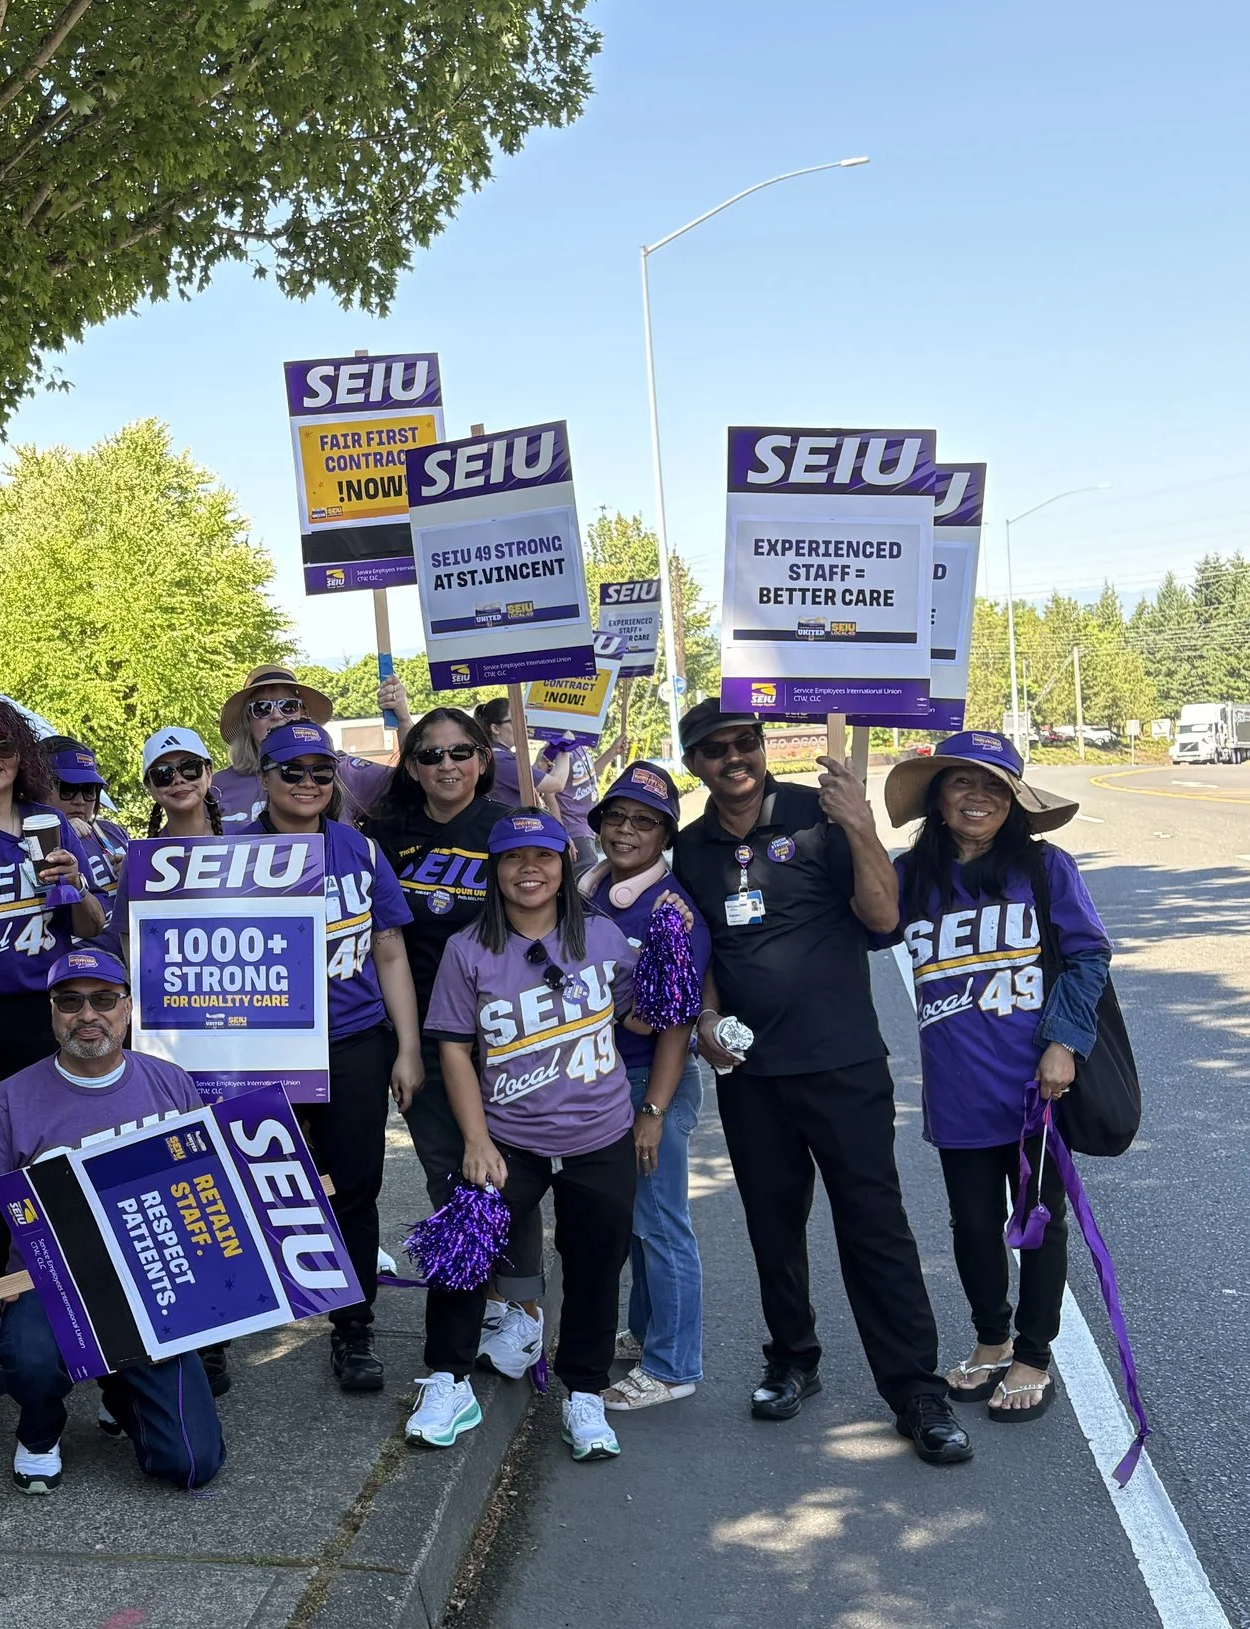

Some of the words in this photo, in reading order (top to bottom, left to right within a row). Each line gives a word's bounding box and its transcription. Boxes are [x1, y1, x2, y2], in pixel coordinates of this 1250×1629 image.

[303, 360, 428, 408] SEIU
[320, 431, 362, 451] FAIR
[366, 427, 418, 447] FIRST
[325, 451, 407, 472] CONTRAC
[421, 431, 555, 497] SEIU
[747, 434, 922, 486] SEIU
[431, 550, 472, 568] SEIU
[475, 545, 492, 560] 49
[494, 535, 563, 558] STRONG
[753, 538, 902, 559] EXPERIENCED
[434, 572, 456, 590] AT
[788, 564, 850, 581] STAFF
[605, 582, 658, 603] SEIU
[759, 587, 836, 605] BETTER
[841, 588, 894, 607] CARE
[508, 603, 533, 612] SEIU
[608, 618, 652, 626] EXPERIENCED
[832, 623, 855, 632] SEIU
[500, 662, 525, 670] Employees
[452, 674, 470, 682] SEIU
[543, 680, 595, 691] CONTRACT
[544, 691, 586, 706] !NOW!
[751, 695, 776, 703] SEIU
[145, 843, 308, 892] SEIU
[400, 853, 487, 889] EIU
[456, 887, 473, 895] OUR
[164, 927, 287, 963] 1000+
[904, 903, 1040, 969] SEIU
[164, 965, 289, 992] STRONG
[164, 996, 189, 1007] FOR
[191, 995, 250, 1007] QUALITY
[253, 995, 289, 1007] CARE
[978, 966, 1044, 1016] 49
[489, 1048, 560, 1102] Local
[566, 1024, 615, 1083] 49
[170, 1136, 186, 1159] SEIU
[10, 1202, 26, 1225] SEIU
[229, 1118, 349, 1290] SEIU
[170, 1182, 213, 1257] STAFF.
[192, 1174, 243, 1259] RETAIN
[139, 1191, 196, 1285] RESPECT
[117, 1198, 176, 1316] PATIENTS.
[37, 1238, 50, 1259] Service
[48, 1260, 63, 1292] Employees
[60, 1291, 78, 1330] International
[75, 1328, 85, 1349] Union
